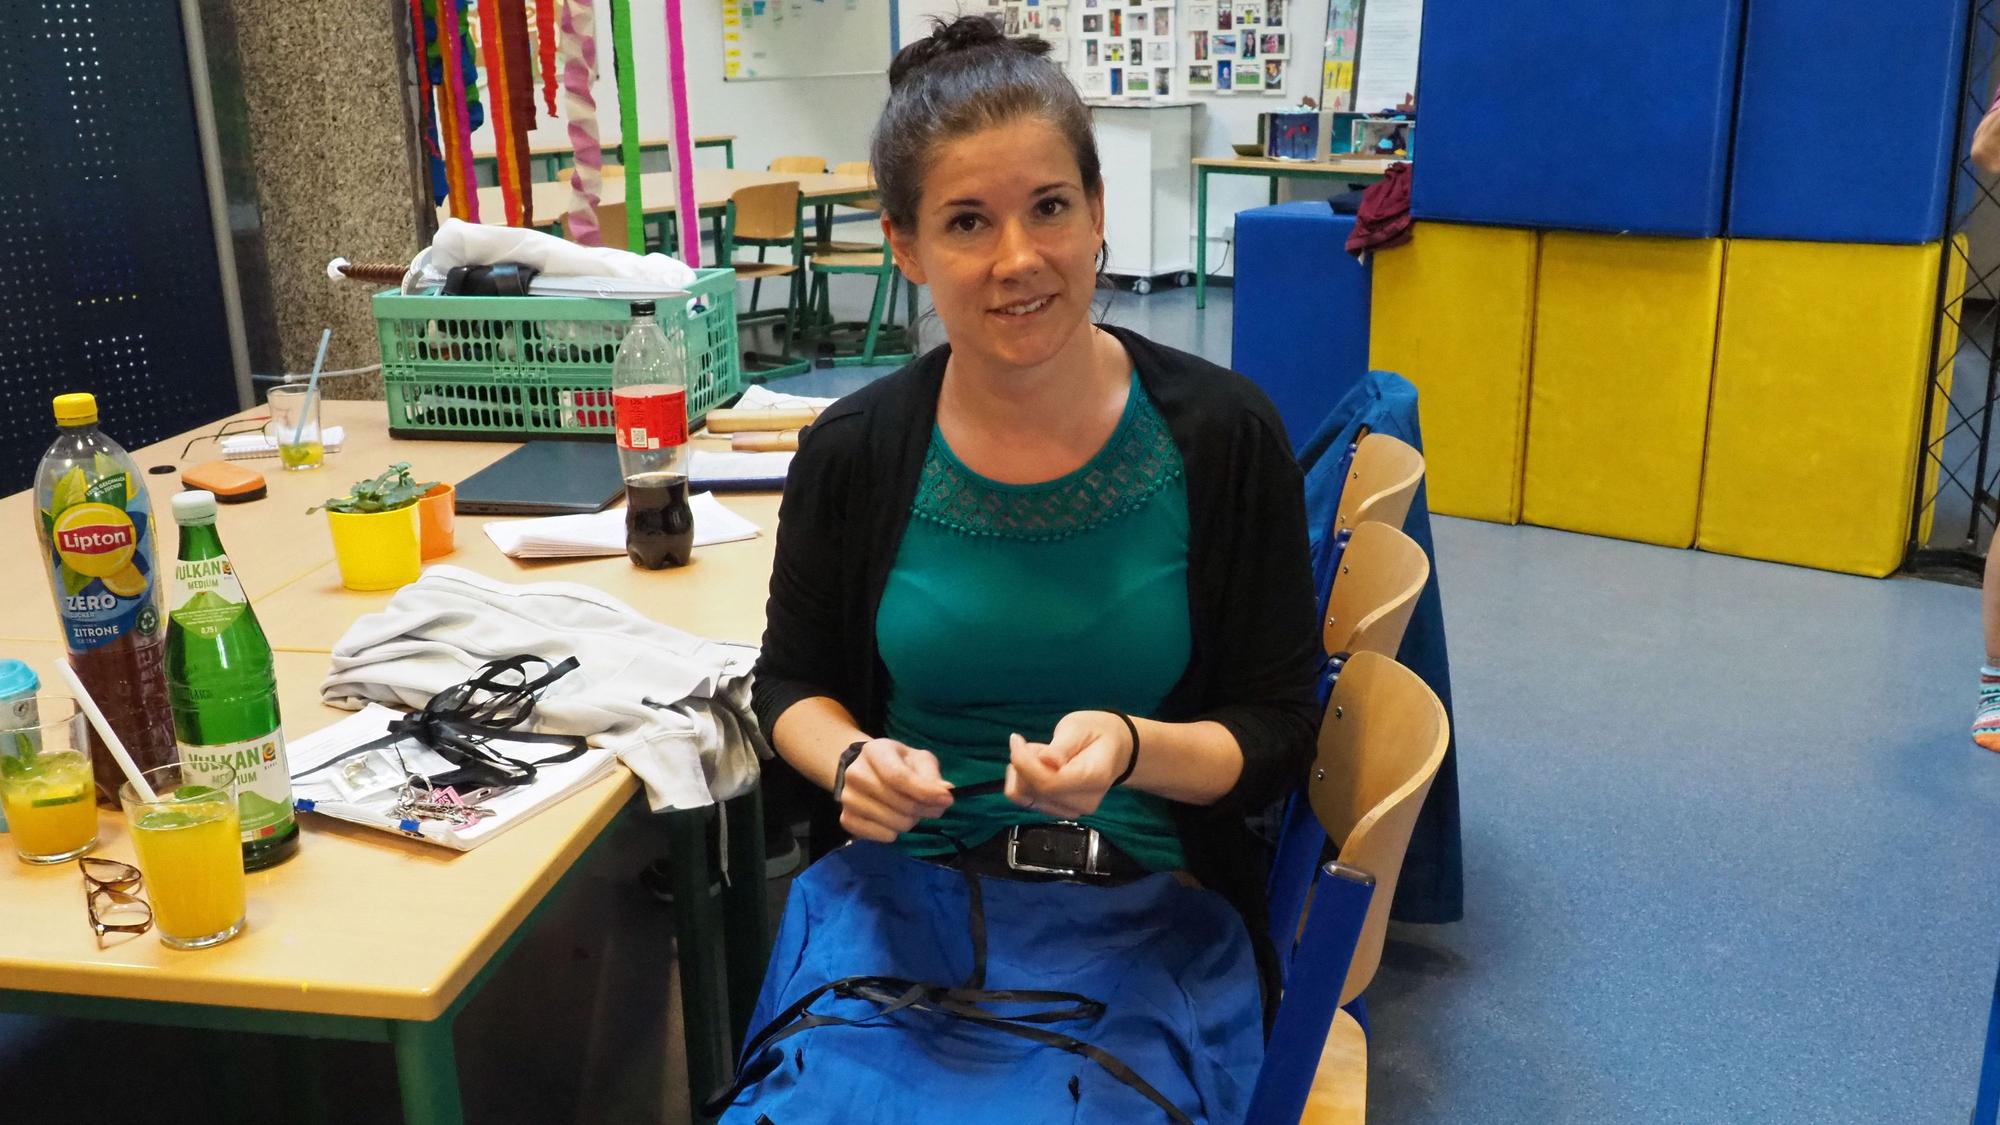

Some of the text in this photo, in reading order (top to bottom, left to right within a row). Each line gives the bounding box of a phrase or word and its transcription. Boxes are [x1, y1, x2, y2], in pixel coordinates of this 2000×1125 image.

[63, 531, 127, 551] Lipton
[187, 578, 219, 590] MEDIUM
[66, 594, 117, 611] ZERO
[73, 625, 120, 638] ZITRONE
[188, 748, 260, 773] VULKAN
